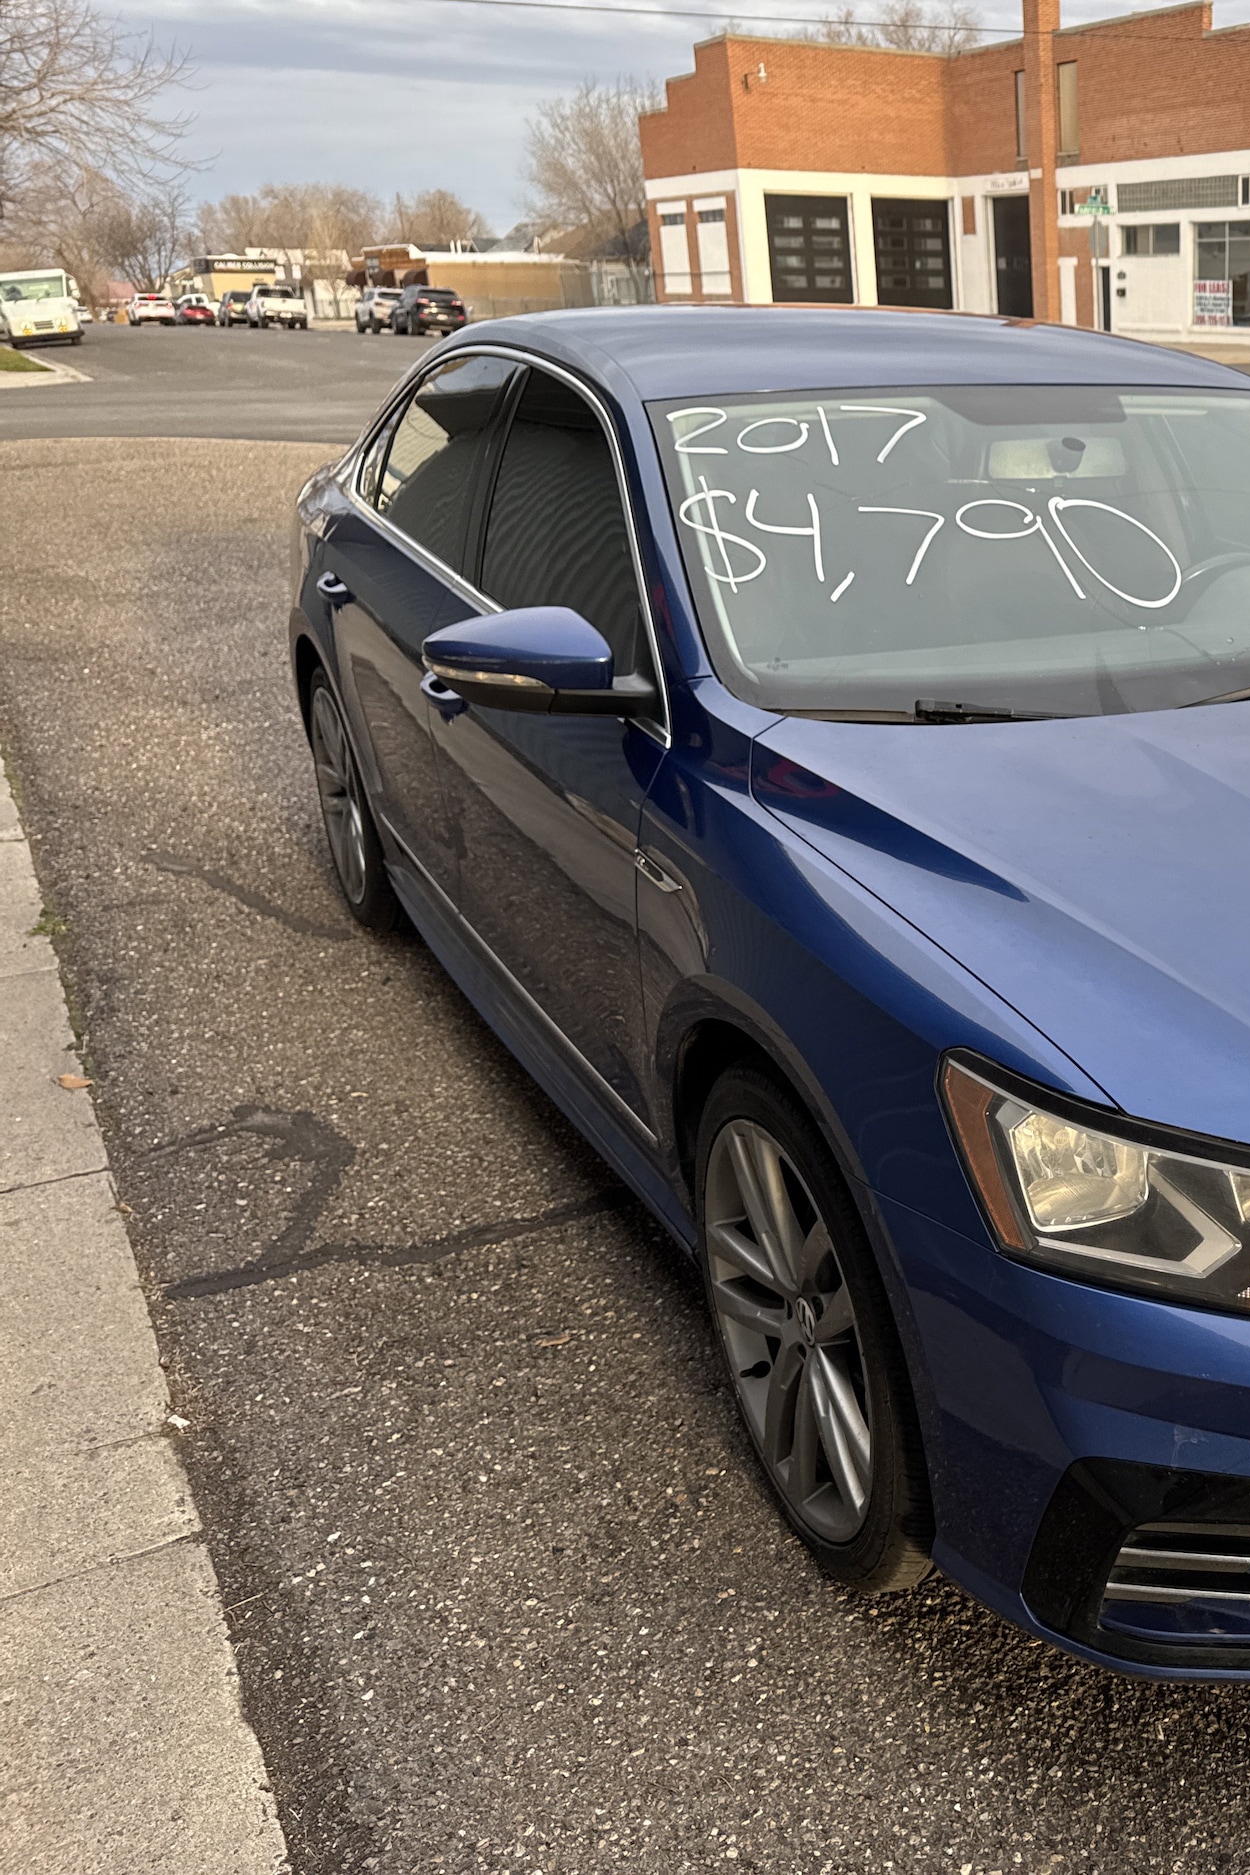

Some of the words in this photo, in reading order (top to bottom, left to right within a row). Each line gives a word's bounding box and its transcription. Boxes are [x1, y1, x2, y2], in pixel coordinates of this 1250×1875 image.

[242, 261, 275, 270] COLLISION
[666, 404, 927, 467] 2017
[678, 475, 1183, 609] $4,790
